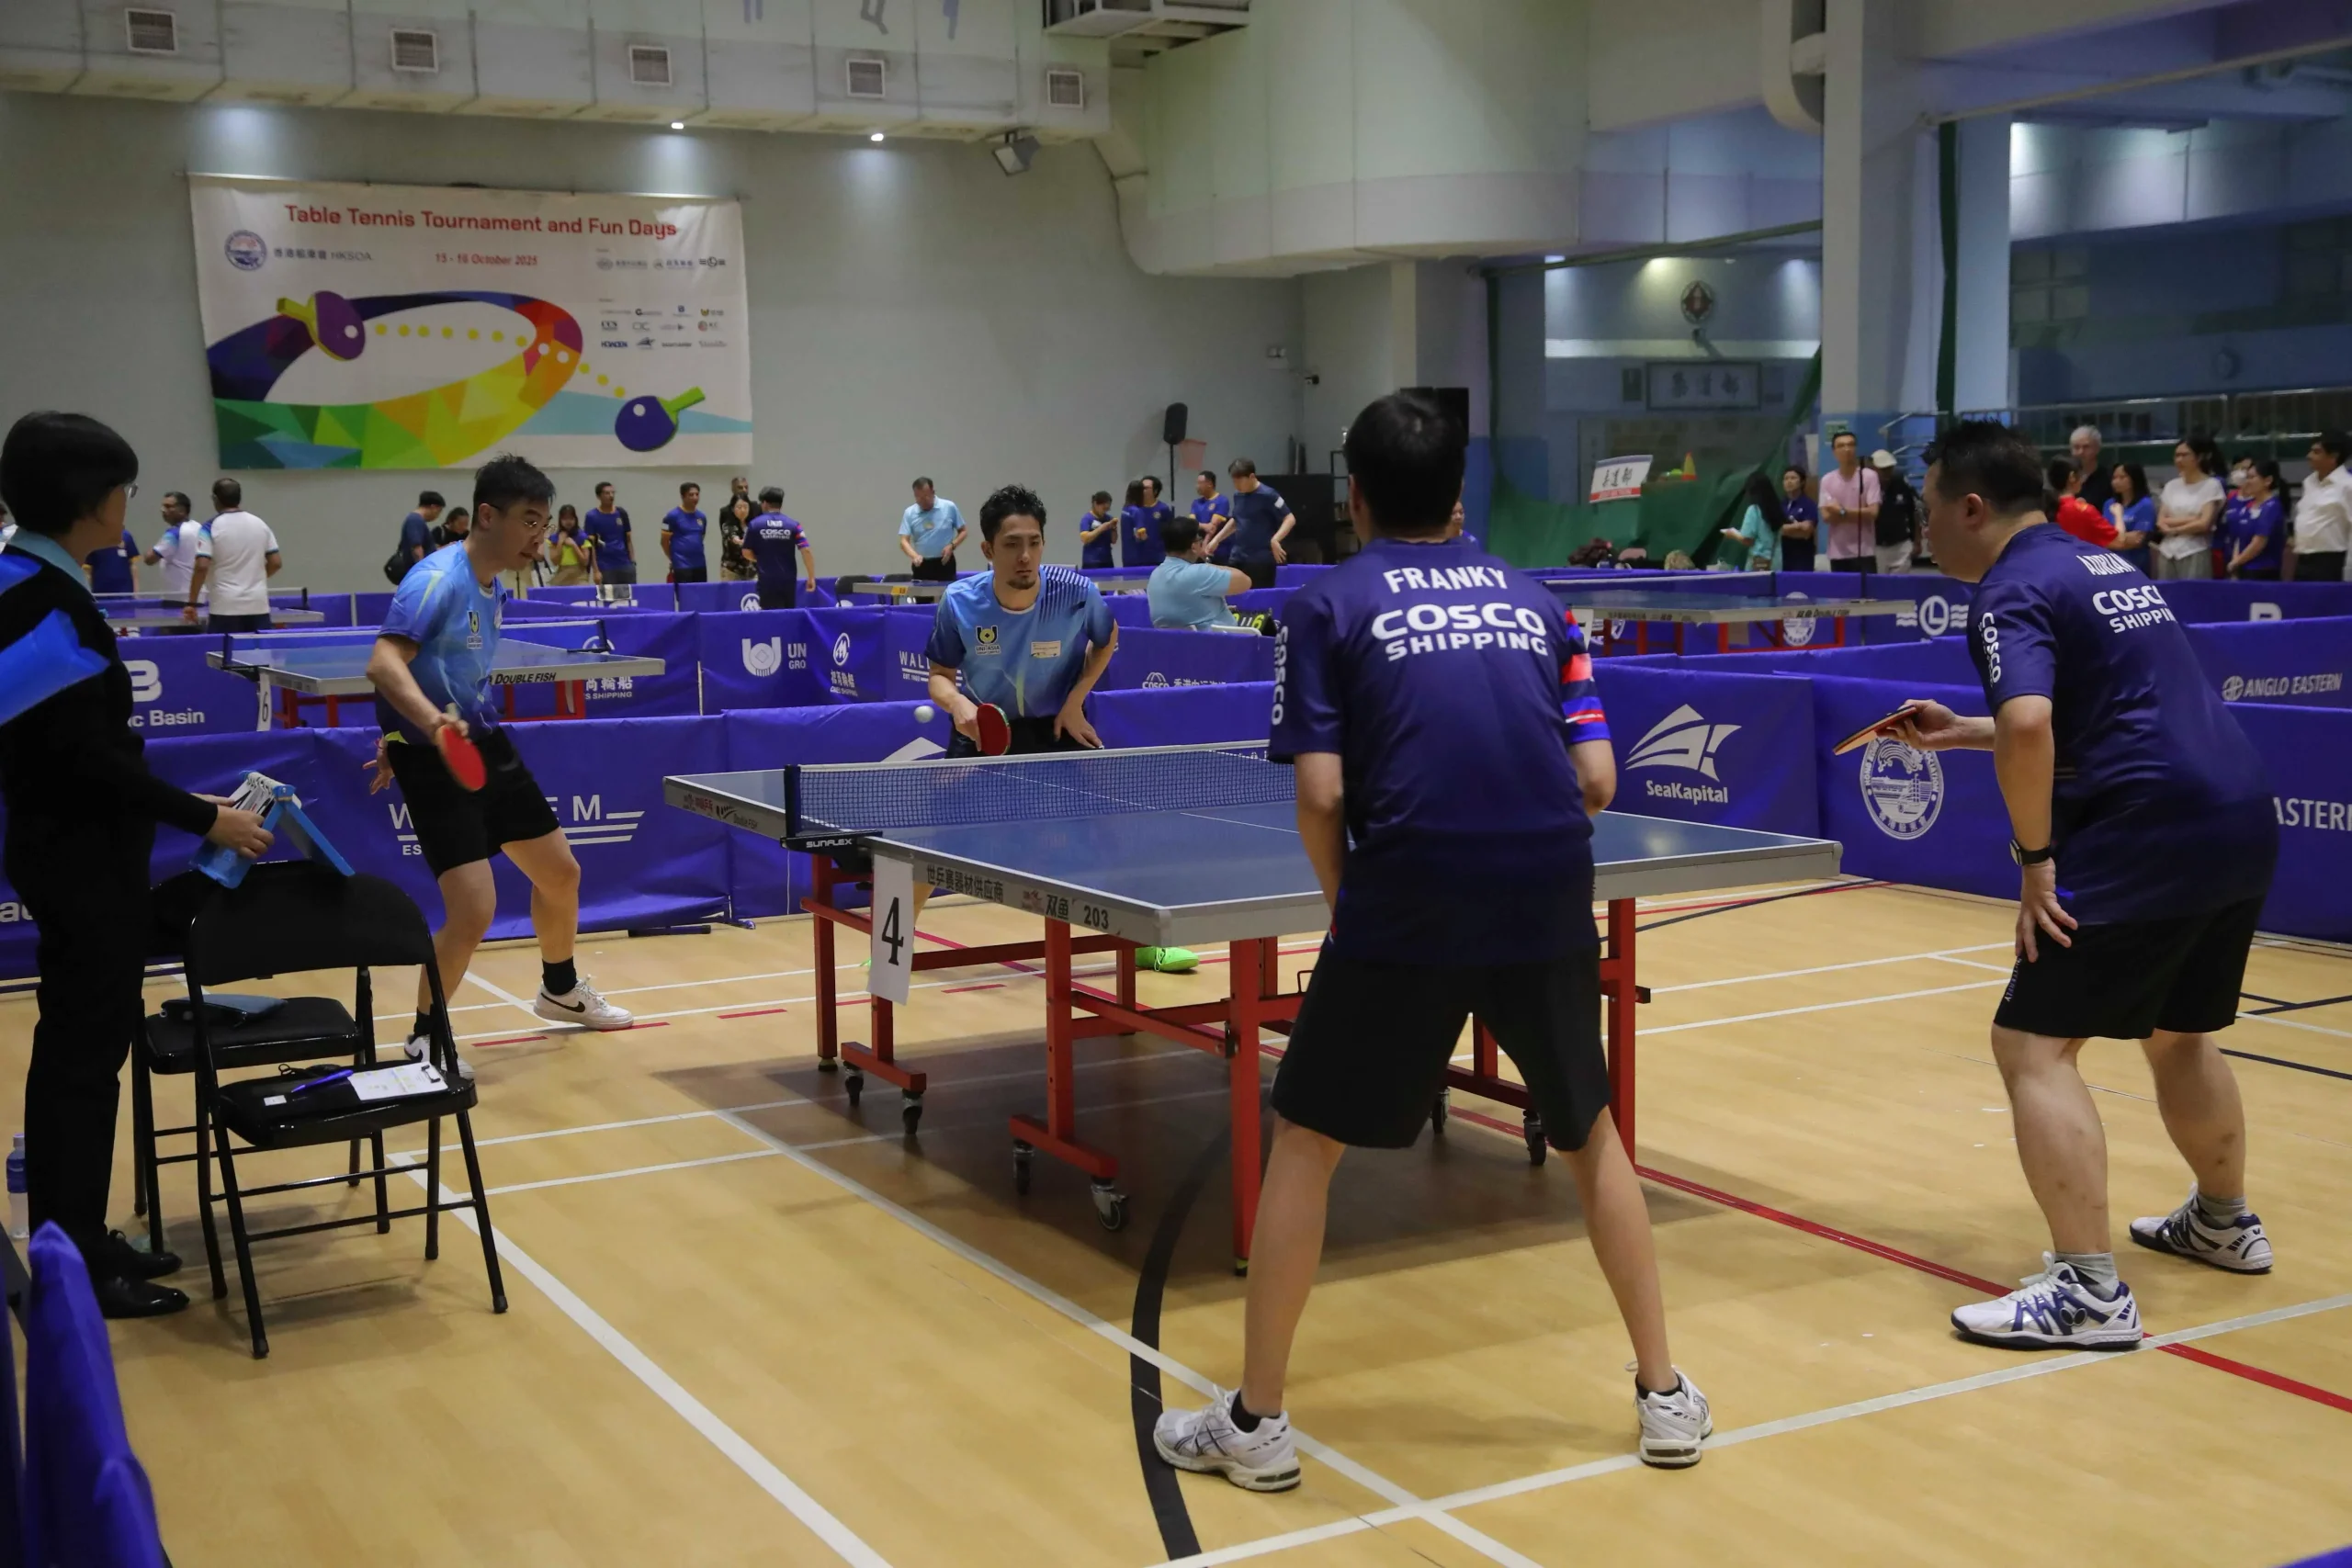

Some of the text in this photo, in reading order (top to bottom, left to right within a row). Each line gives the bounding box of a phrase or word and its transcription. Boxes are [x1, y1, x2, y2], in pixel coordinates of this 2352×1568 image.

[284, 205, 678, 240] Table Tennis Tournament and Fun Days
[470, 254, 512, 265] October
[2076, 553, 2136, 576] ADRIAN
[1383, 566, 1509, 593] FRANKY
[2092, 585, 2168, 615] COSC
[1251, 614, 1265, 630] 6
[1372, 603, 1547, 640] COSCO
[1385, 631, 1549, 661] SHIPPING
[1982, 612, 2001, 683] COSCO
[788, 660, 807, 670] GRO
[1272, 626, 1288, 726] COSCO
[494, 672, 557, 685] DOUBLE FISH
[2243, 672, 2343, 697] ANGLO EASTERN
[150, 708, 205, 727] Basin
[261, 691, 269, 723] 6
[1645, 780, 1729, 806] SeaKapital
[2273, 796, 2352, 831] STER
[401, 844, 423, 856] ES
[806, 838, 853, 848] SUNFLEX
[927, 864, 1004, 905] 世乒赛器材供应商
[1046, 895, 1069, 920] 双鱼
[1084, 905, 1109, 930] 203
[881, 897, 904, 966] 4
